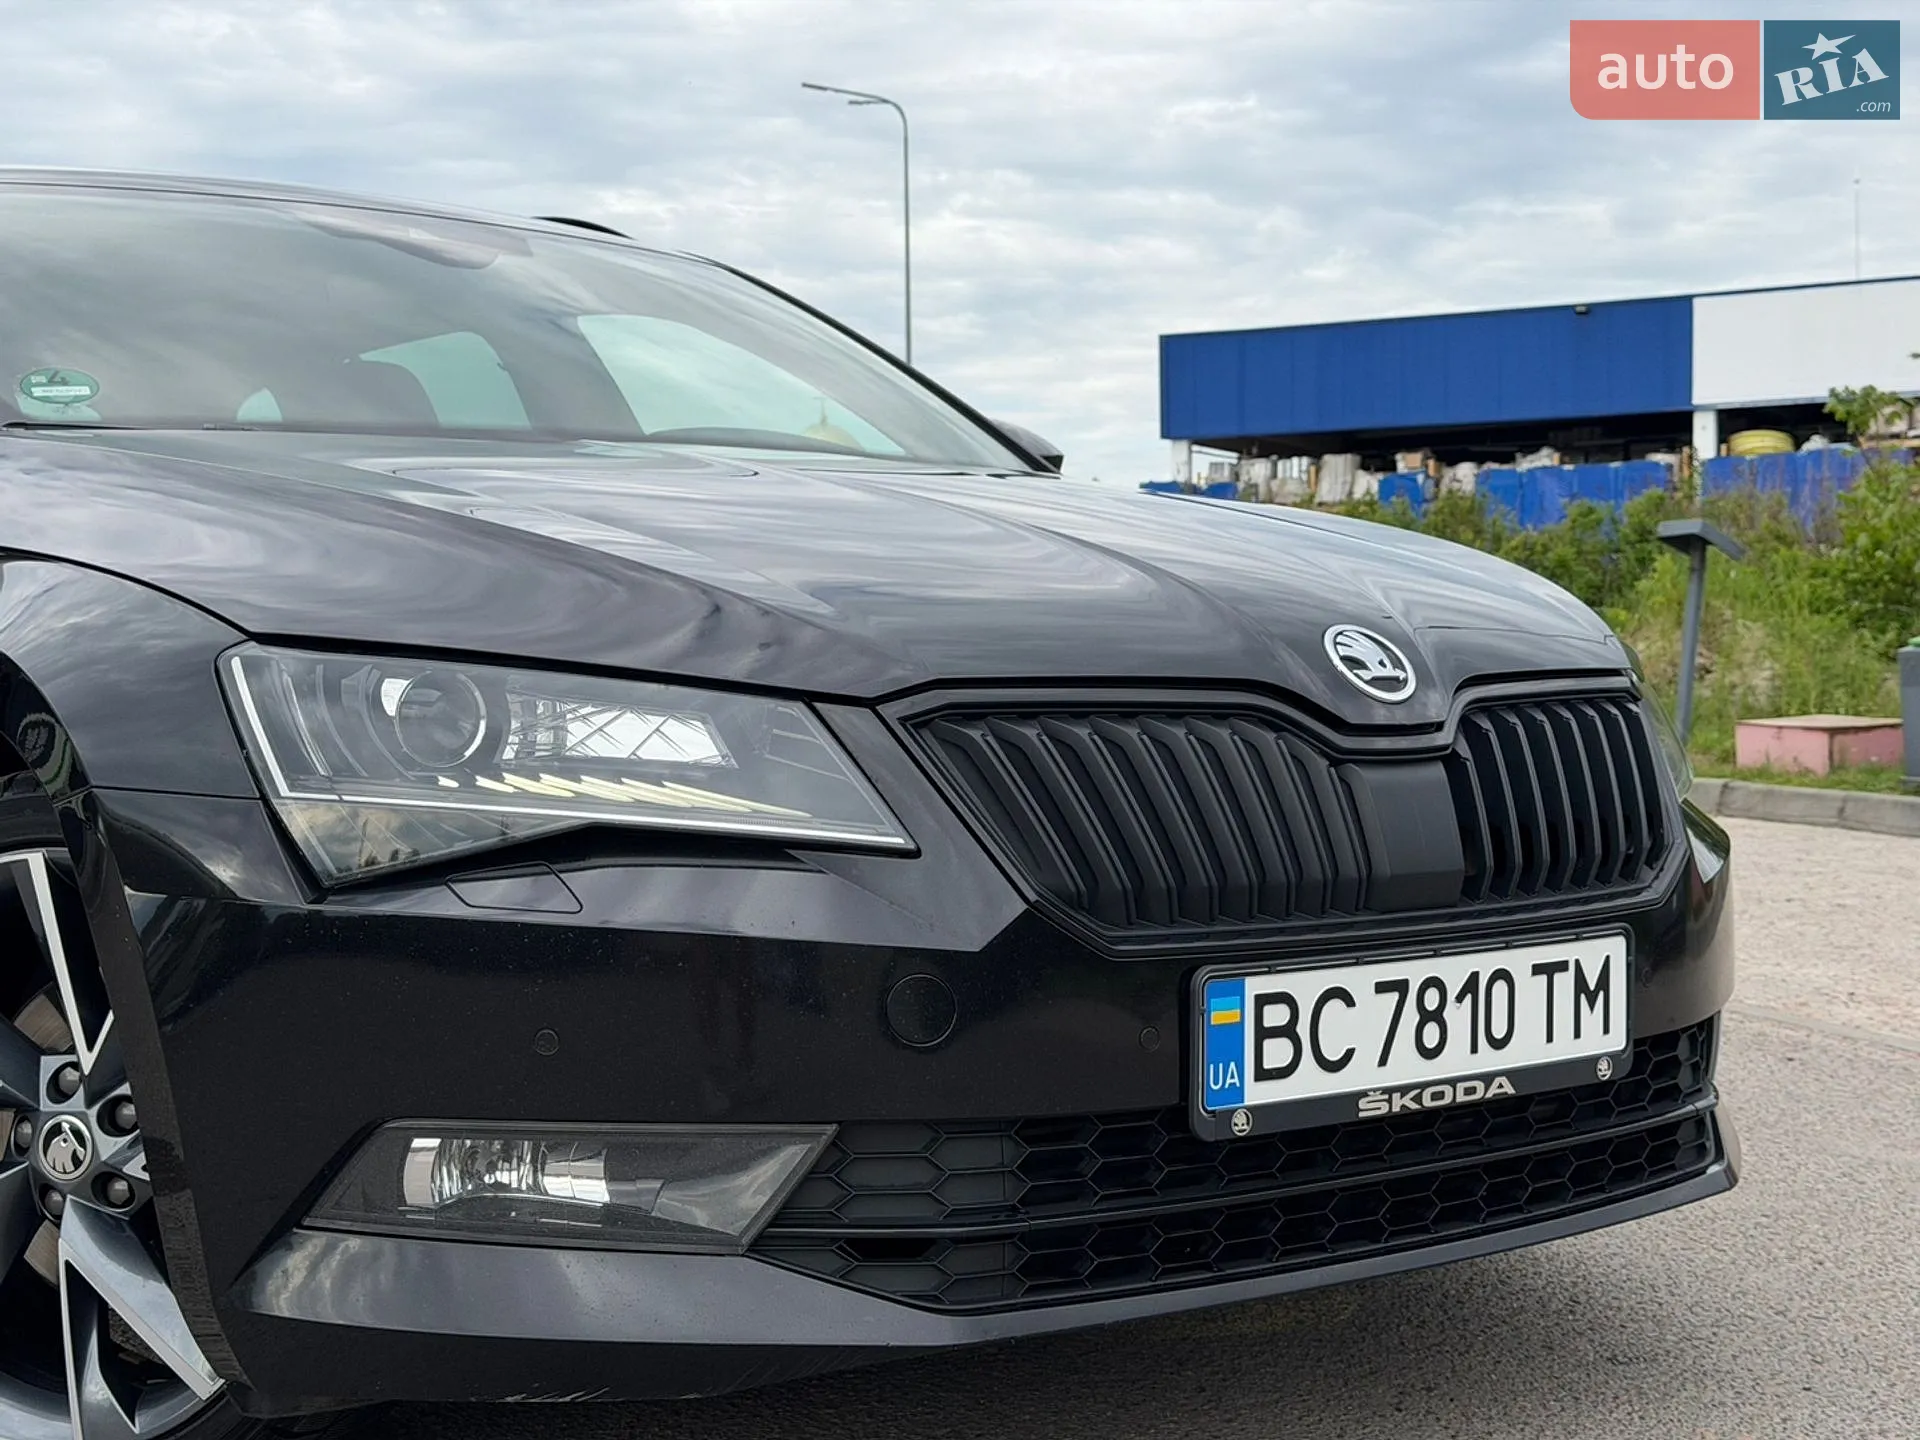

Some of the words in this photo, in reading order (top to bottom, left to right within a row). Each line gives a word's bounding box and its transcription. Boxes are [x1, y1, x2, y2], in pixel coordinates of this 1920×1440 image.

[1253, 986, 1357, 1083] BC
[1374, 966, 1516, 1068] 7810
[1531, 953, 1612, 1045] TM
[1209, 1063, 1240, 1091] UA
[1358, 1076, 1516, 1119] ŠKODA
